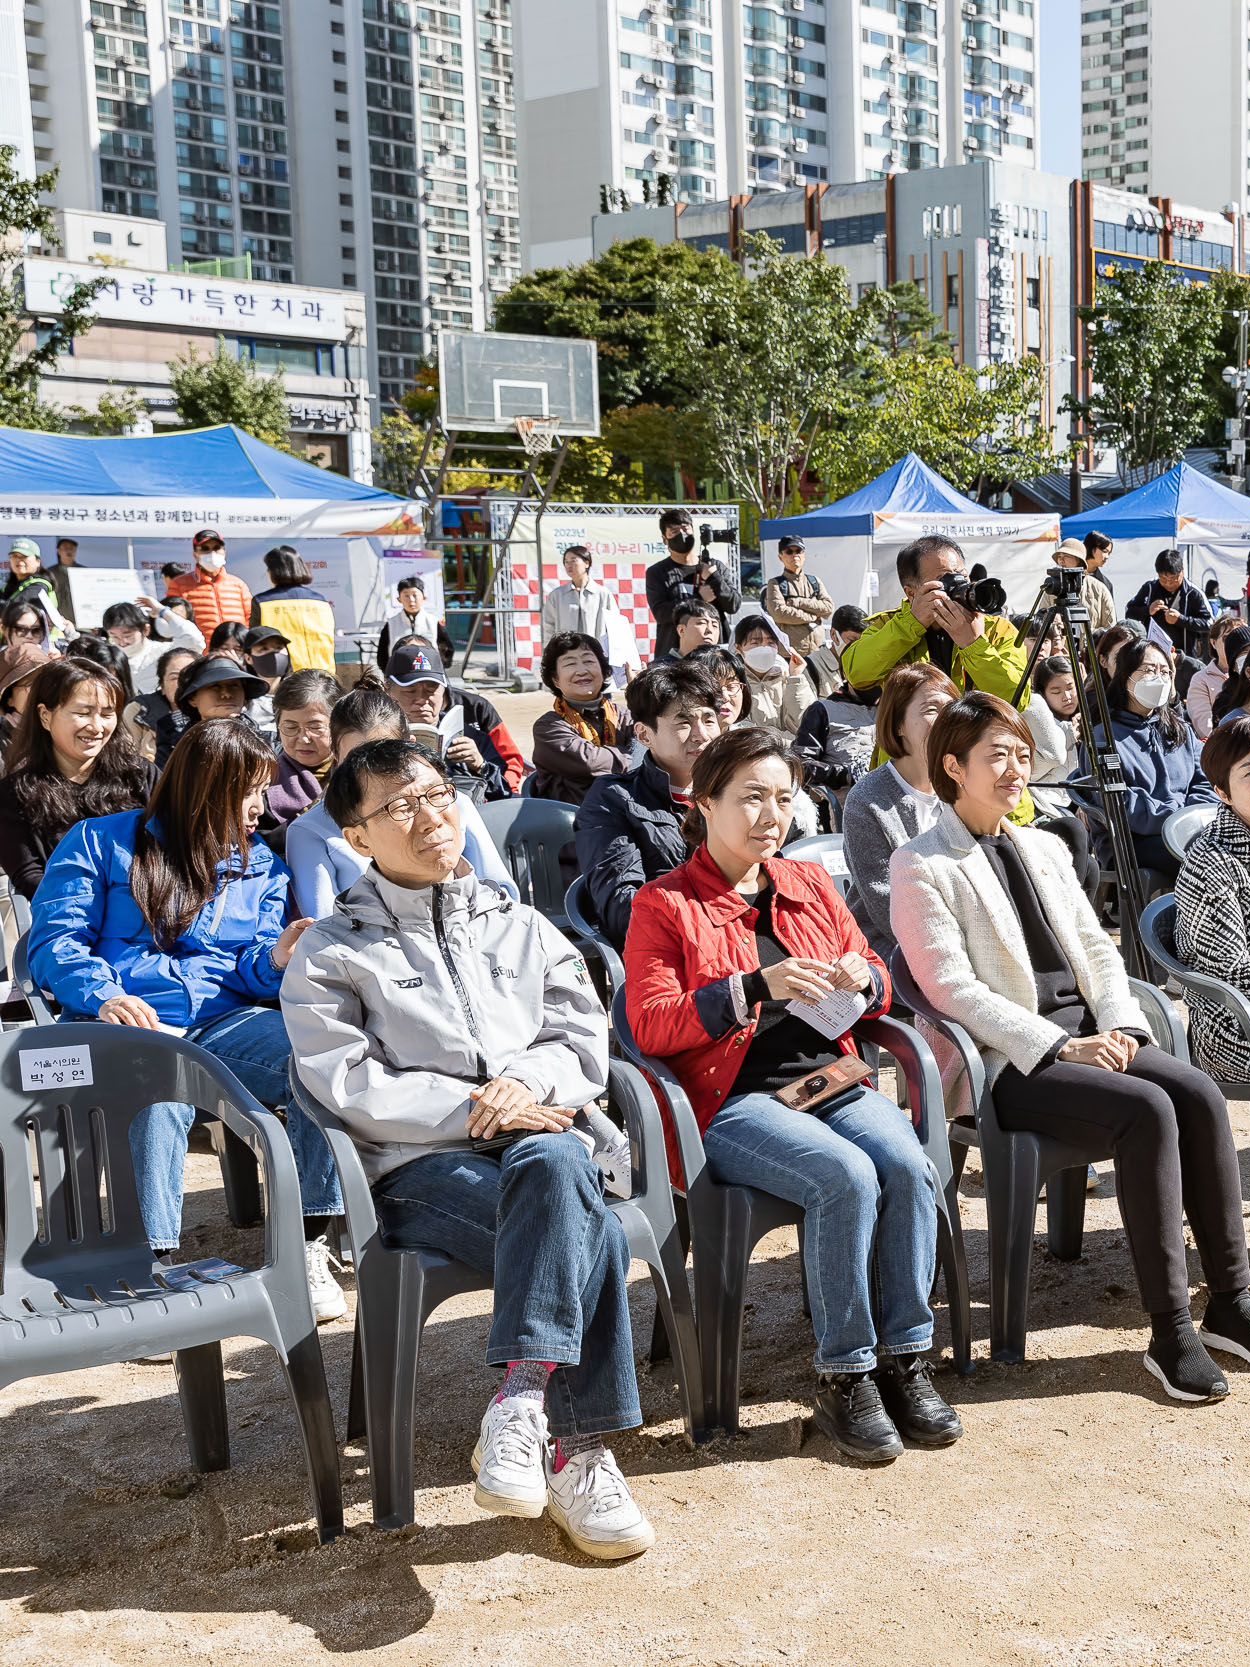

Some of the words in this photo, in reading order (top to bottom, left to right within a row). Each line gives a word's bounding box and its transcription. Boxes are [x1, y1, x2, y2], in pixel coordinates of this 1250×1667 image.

[170, 287, 258, 317] 가득한
[271, 298, 326, 322] 치과
[284, 404, 351, 422] 의료센터
[48, 508, 89, 521] 광진구
[95, 508, 148, 523] 청소년과
[154, 510, 220, 524] 함께합니다
[554, 528, 586, 538] 2023년
[922, 525, 939, 536] 우리
[941, 525, 974, 537] 가족사진
[977, 526, 993, 537] 액자
[33, 1057, 81, 1069] 서울시의원
[31, 1073, 44, 1084] 박
[52, 1071, 64, 1083] 성
[71, 1069, 85, 1081] 연
